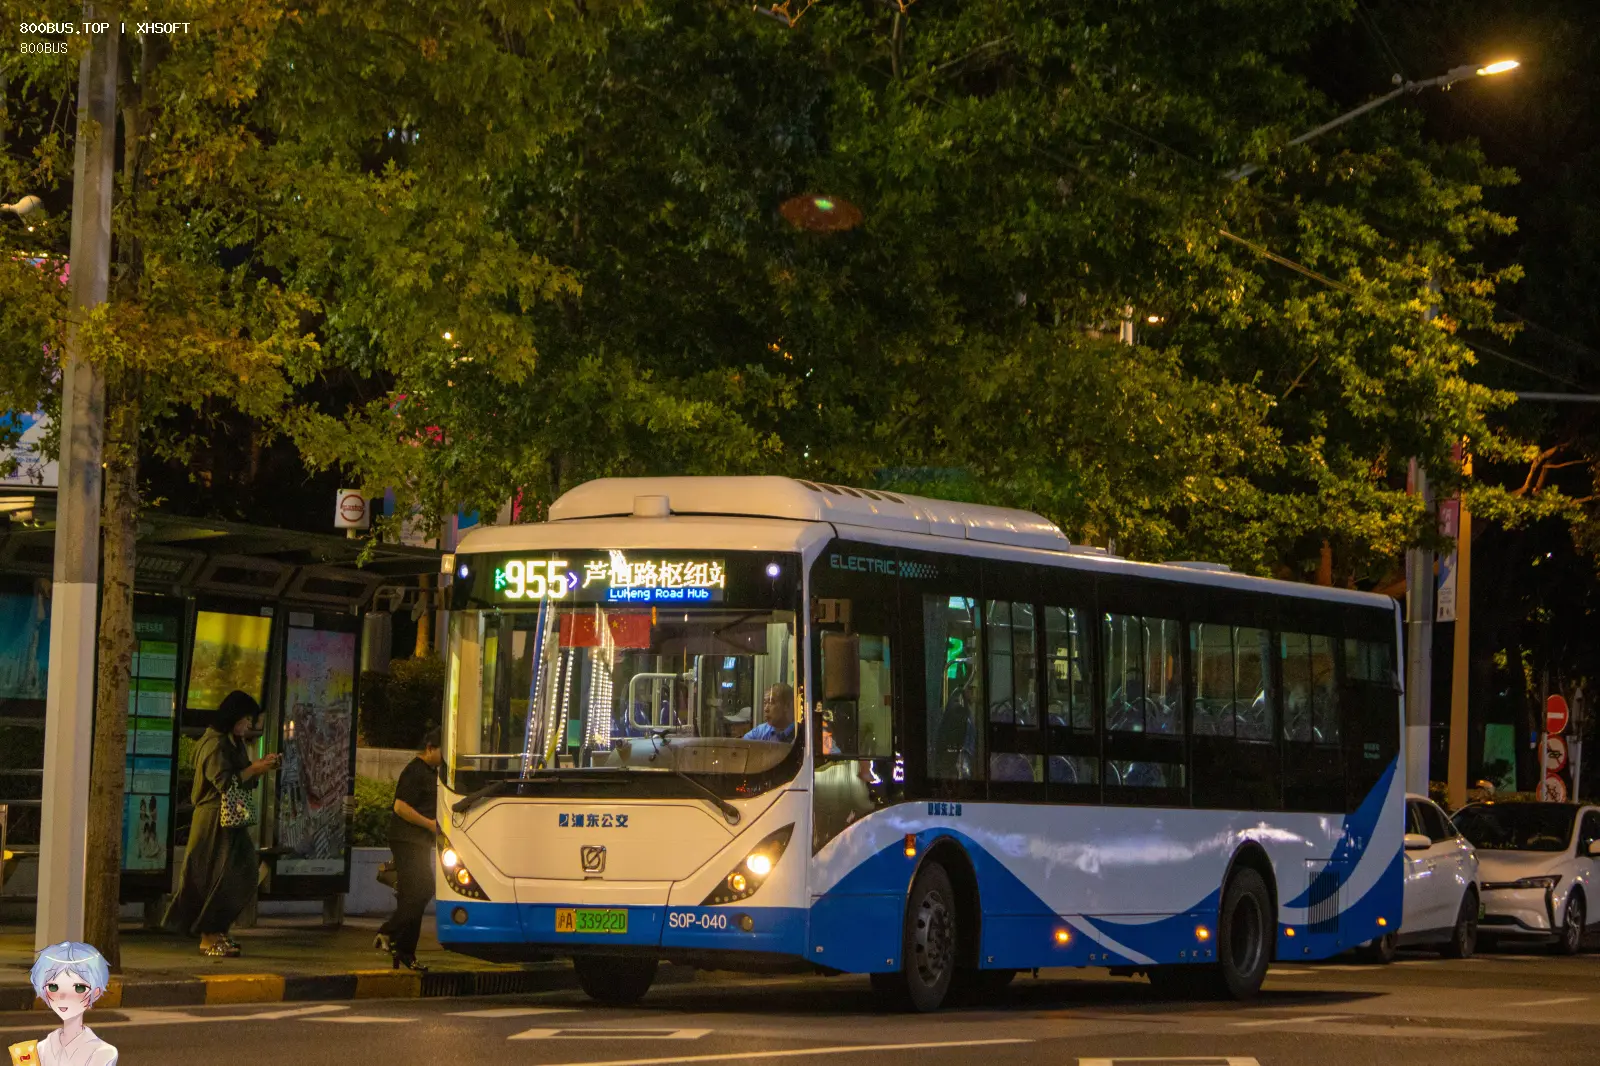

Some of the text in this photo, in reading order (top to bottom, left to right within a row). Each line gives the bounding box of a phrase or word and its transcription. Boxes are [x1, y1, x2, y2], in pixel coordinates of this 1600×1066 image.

[830, 553, 897, 575] ELECTRIC
[655, 588, 684, 599] Road
[687, 588, 709, 599] Hub
[571, 812, 629, 828] 浦东公交
